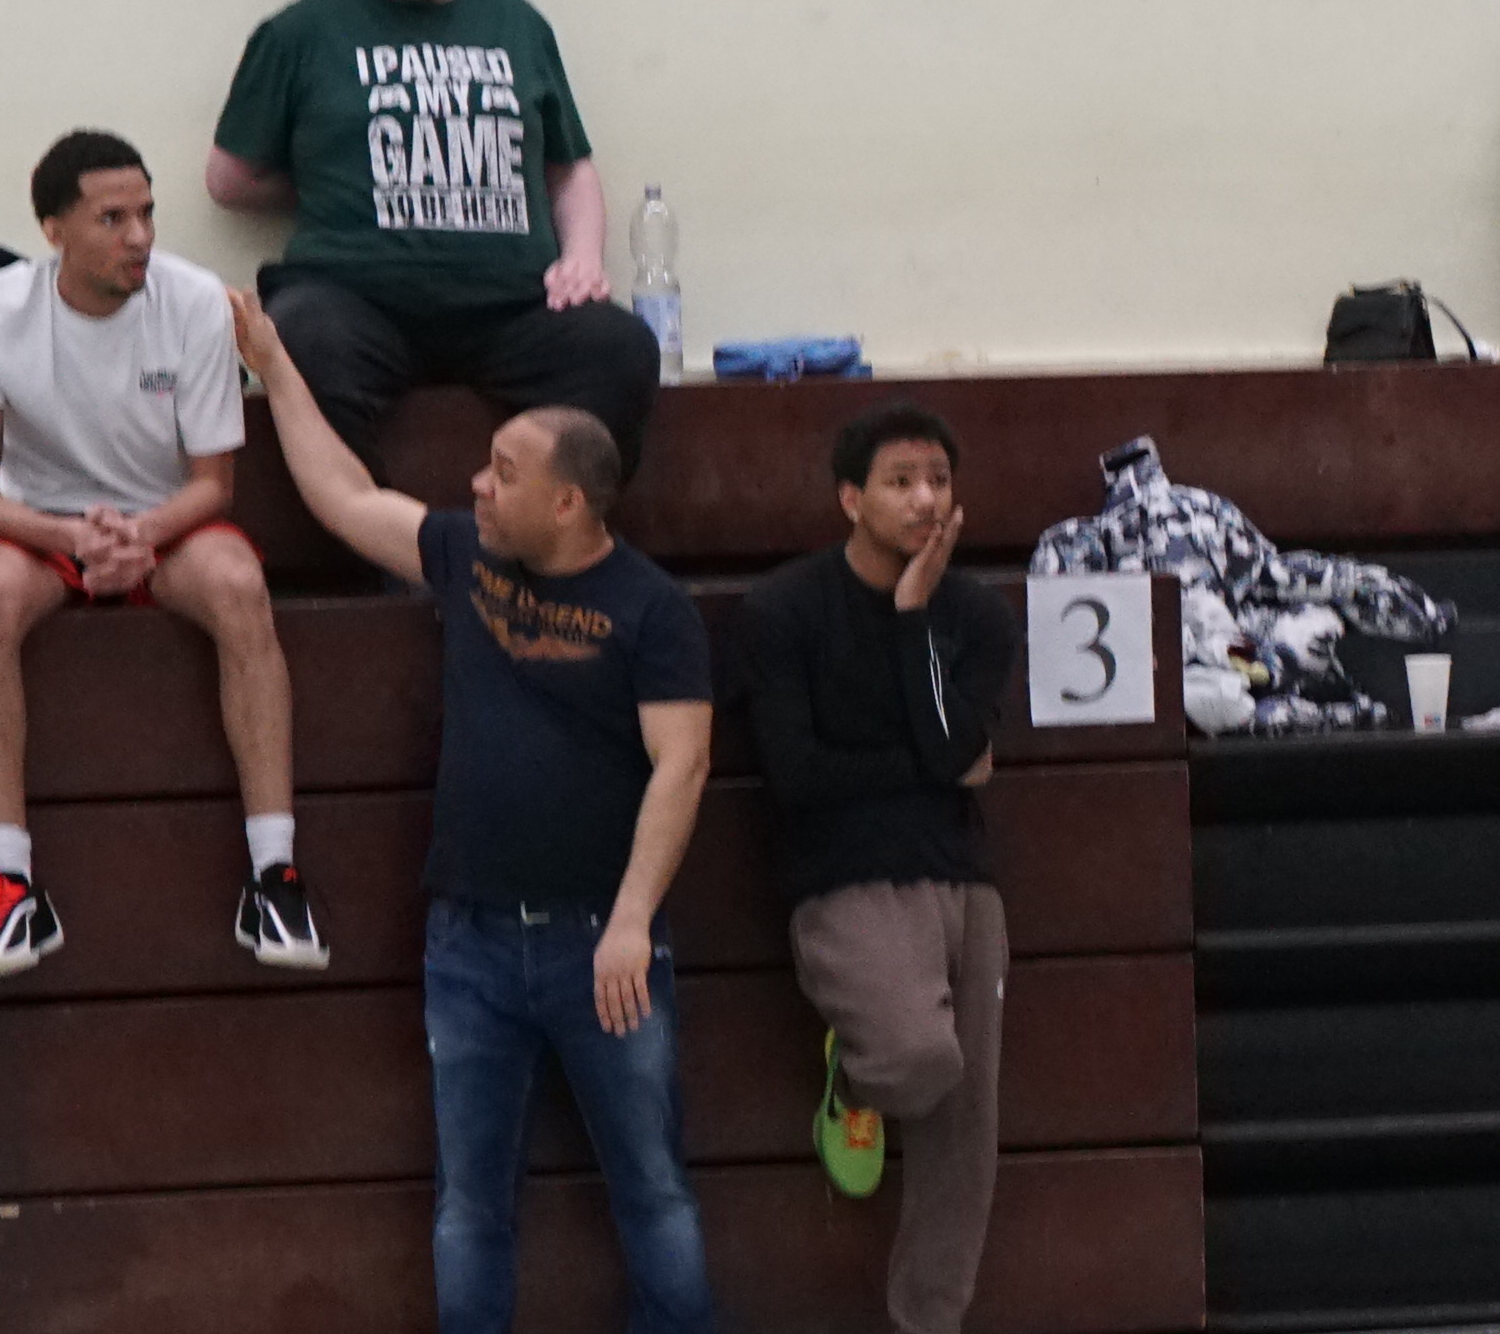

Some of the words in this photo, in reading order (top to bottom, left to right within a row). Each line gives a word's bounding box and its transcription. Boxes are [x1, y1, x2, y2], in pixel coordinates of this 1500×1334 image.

[372, 42, 514, 87] PAUSED
[415, 78, 470, 118] MY
[367, 114, 525, 193] GAME
[1060, 593, 1117, 705] 3
